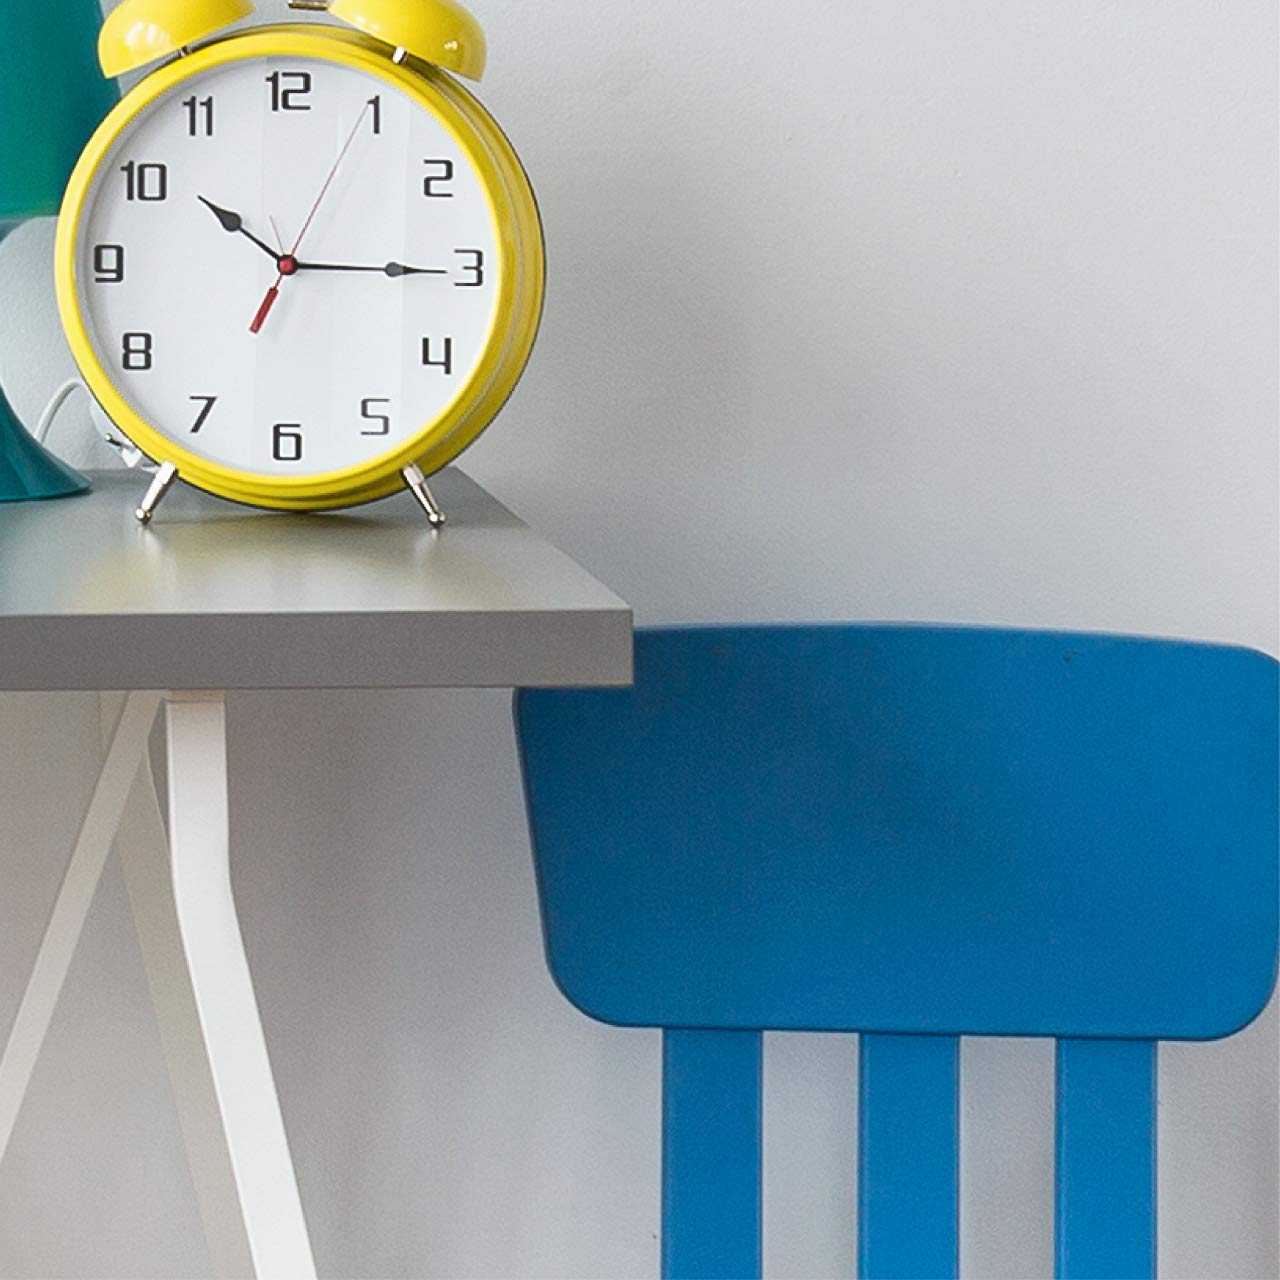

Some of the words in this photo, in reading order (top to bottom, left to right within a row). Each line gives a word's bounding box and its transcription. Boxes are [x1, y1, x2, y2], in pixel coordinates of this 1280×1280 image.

[266, 71, 311, 111] 12
[182, 95, 213, 136] 11
[366, 95, 380, 135] 1
[120, 159, 168, 202] 10
[424, 160, 453, 197] 2
[93, 245, 123, 283] 9
[455, 250, 482, 286] 3
[123, 333, 151, 370] 8
[423, 338, 451, 374] 4
[190, 396, 216, 433] 7
[362, 399, 388, 435] 5
[273, 424, 302, 460] 6
